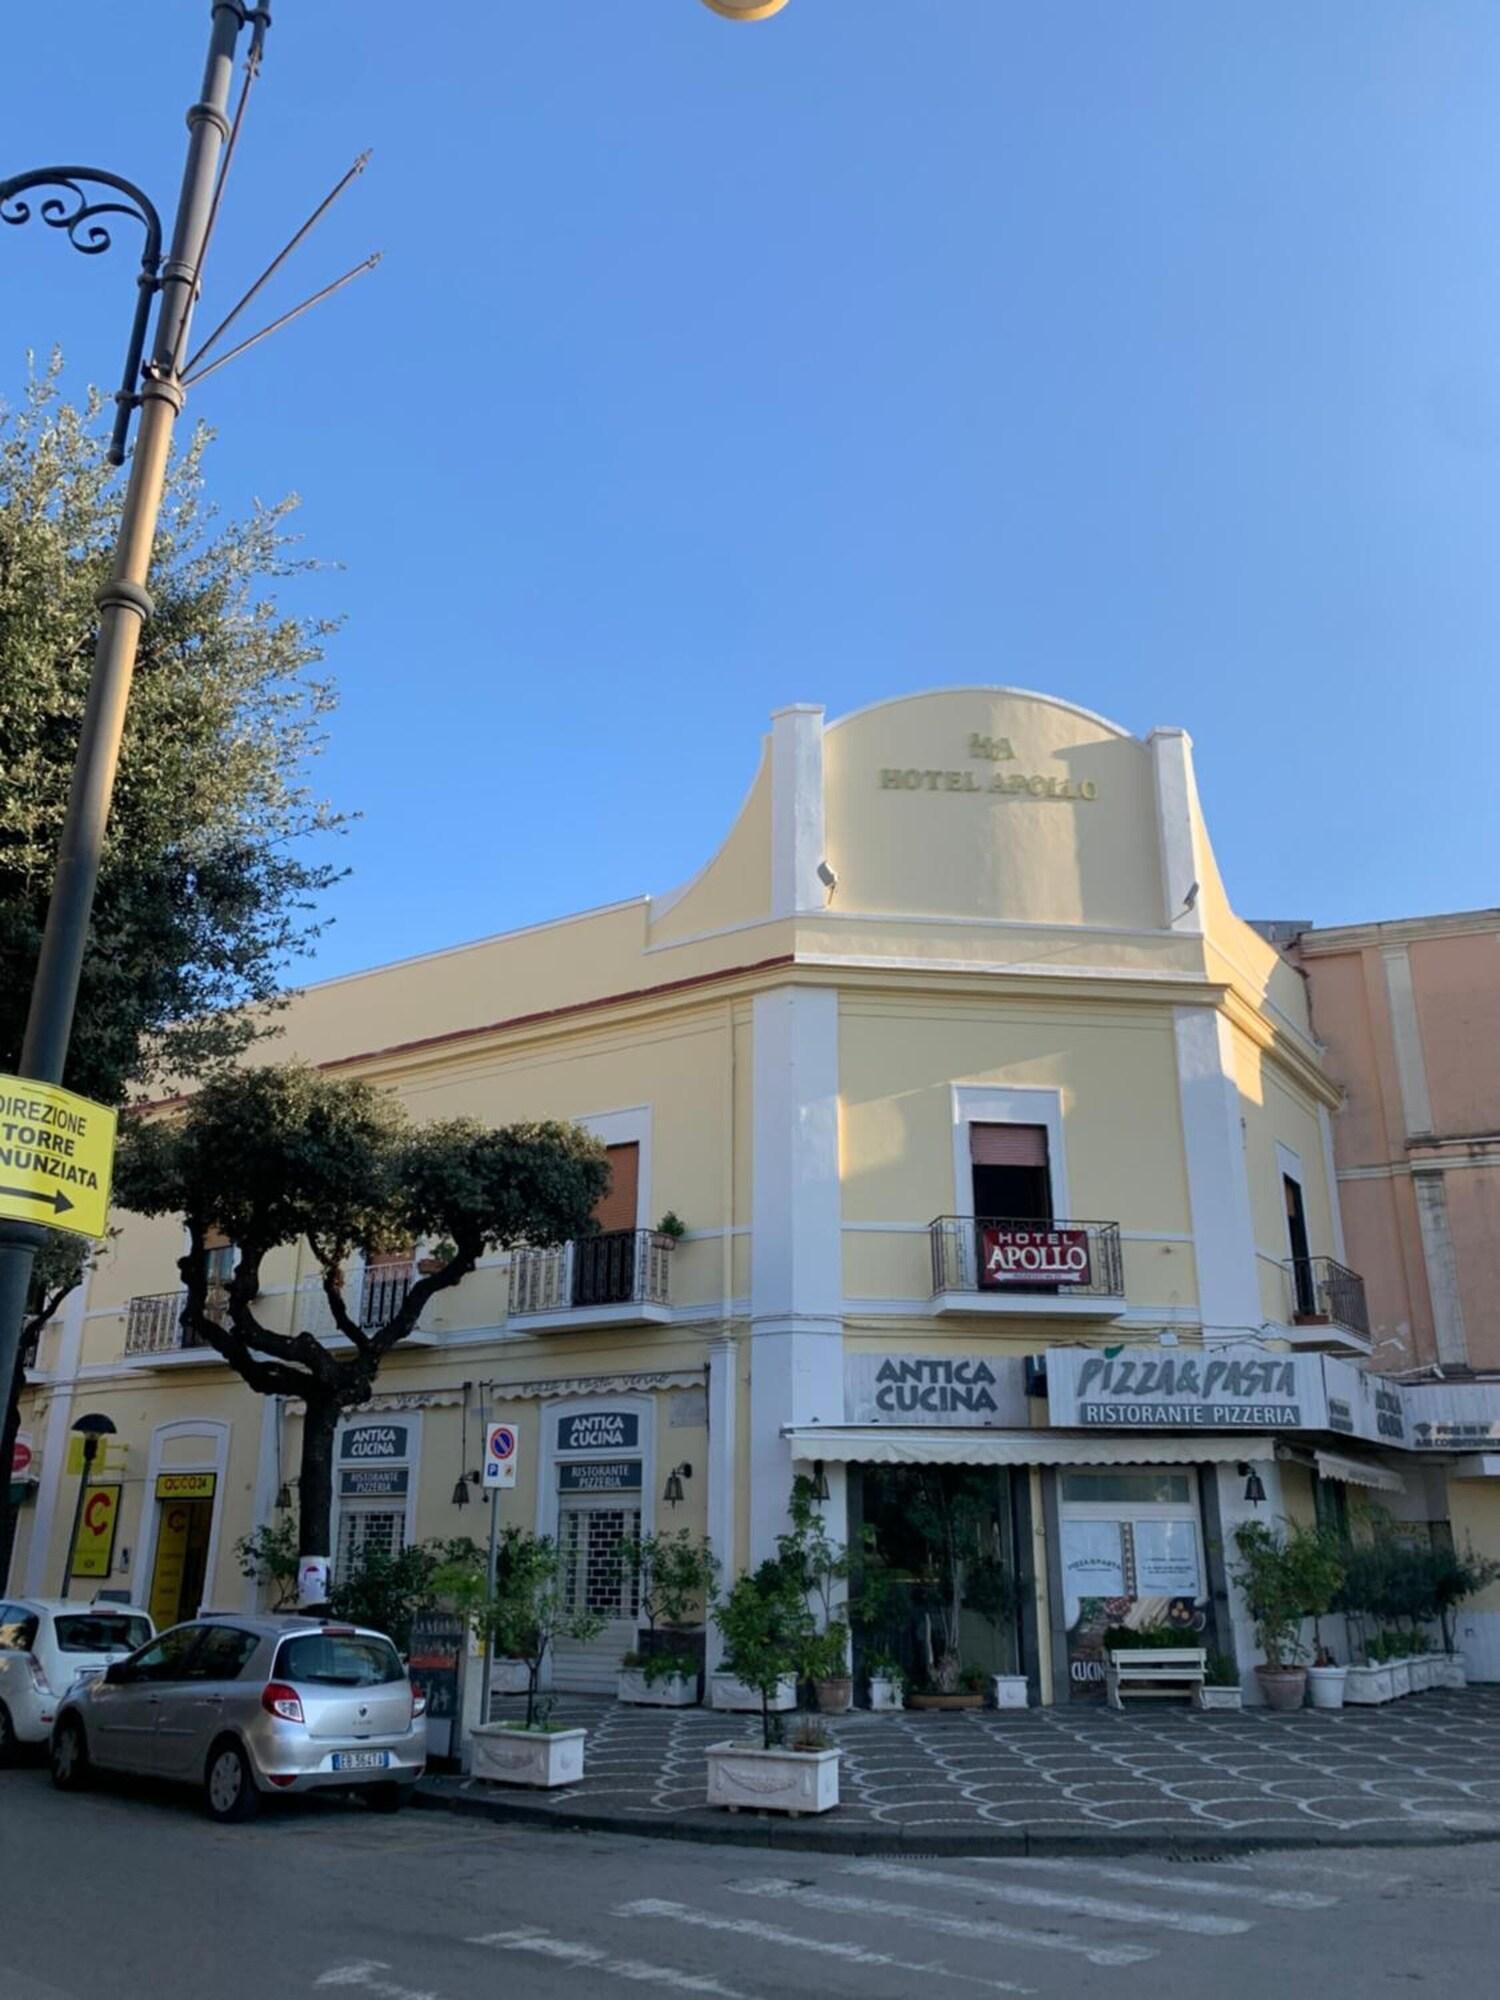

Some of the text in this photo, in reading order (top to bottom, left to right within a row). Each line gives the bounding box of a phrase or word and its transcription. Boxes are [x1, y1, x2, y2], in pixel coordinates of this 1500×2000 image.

[879, 769, 1097, 800] HOTEL APOLLO
[2, 1122, 75, 1157] TORRE
[998, 1231, 1074, 1245] HOTEL
[987, 1246, 1088, 1269] APOLLO
[875, 1358, 997, 1385] ANTICA
[875, 1385, 998, 1413] CUCINA
[1087, 1405, 1297, 1424] RISTORANTE PIZZERIA
[571, 1416, 624, 1431] ANTICA
[353, 1428, 396, 1442] ANTICA
[570, 1430, 624, 1446] CUCINA
[351, 1442, 395, 1456] CUCINA
[351, 1472, 399, 1483] RISTORANTE
[571, 1465, 630, 1477] RISTORANTE
[356, 1483, 392, 1493] PIZZERIA
[578, 1477, 622, 1488] PIZZERIA
